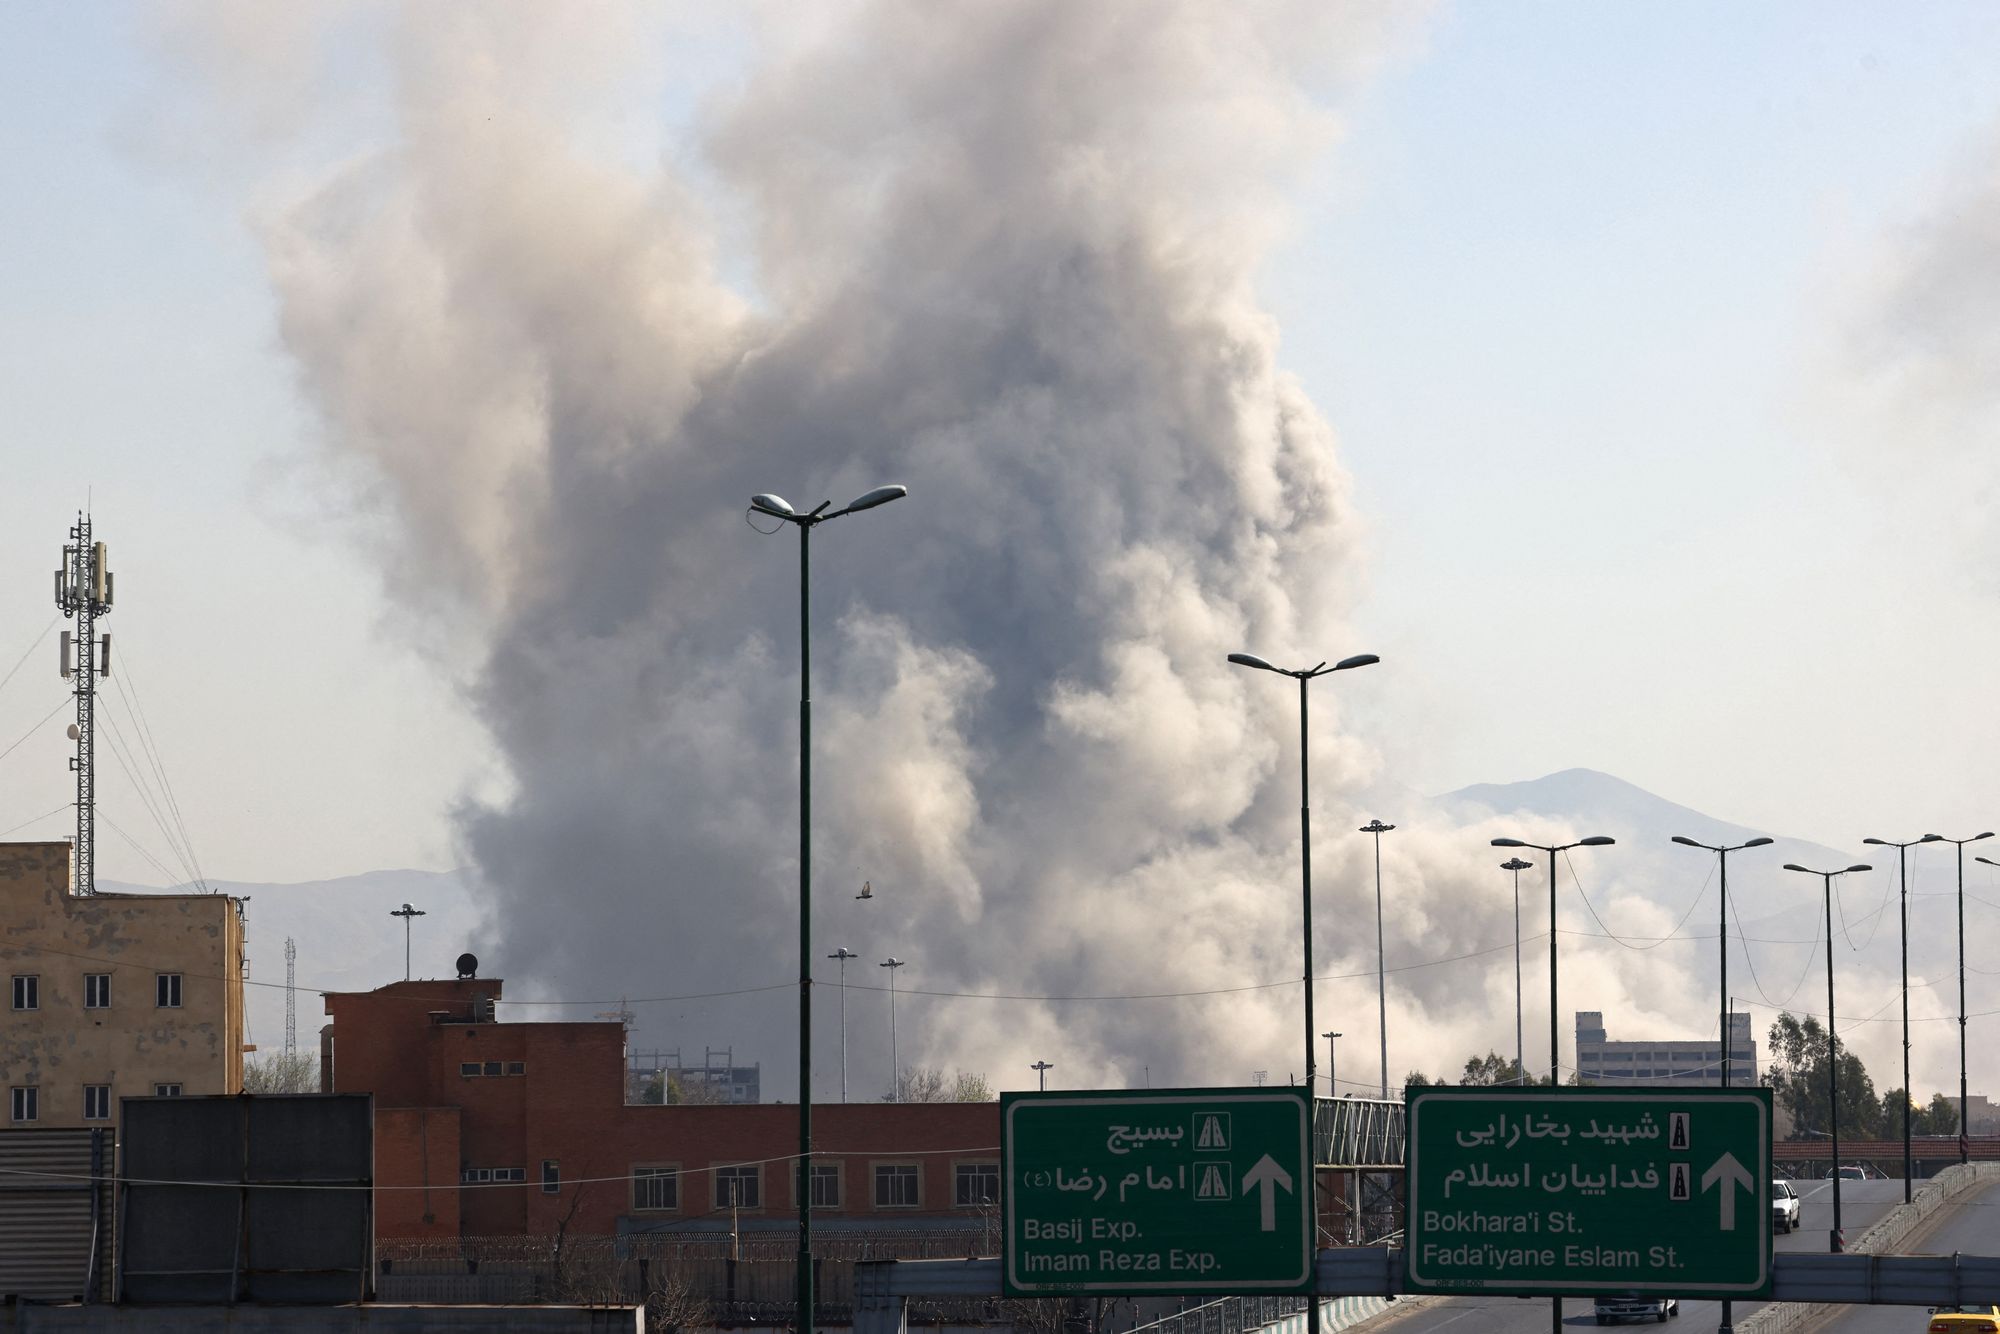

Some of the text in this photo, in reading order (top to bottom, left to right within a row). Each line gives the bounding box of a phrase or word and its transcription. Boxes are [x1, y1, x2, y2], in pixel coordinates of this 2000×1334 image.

[1107, 1126, 1183, 1154] بسیج
[1456, 1113, 1659, 1149] شهید بخارایی
[1120, 1166, 1184, 1202] امام
[1445, 1163, 1659, 1198] فداییان اسلام
[1025, 1218, 1142, 1243] Basij Exp.
[1424, 1211, 1582, 1232] Bokhara'i St.
[1025, 1249, 1220, 1273] Imam Reza Exp.
[1424, 1244, 1683, 1269] Fada'iyane Eslam St.
